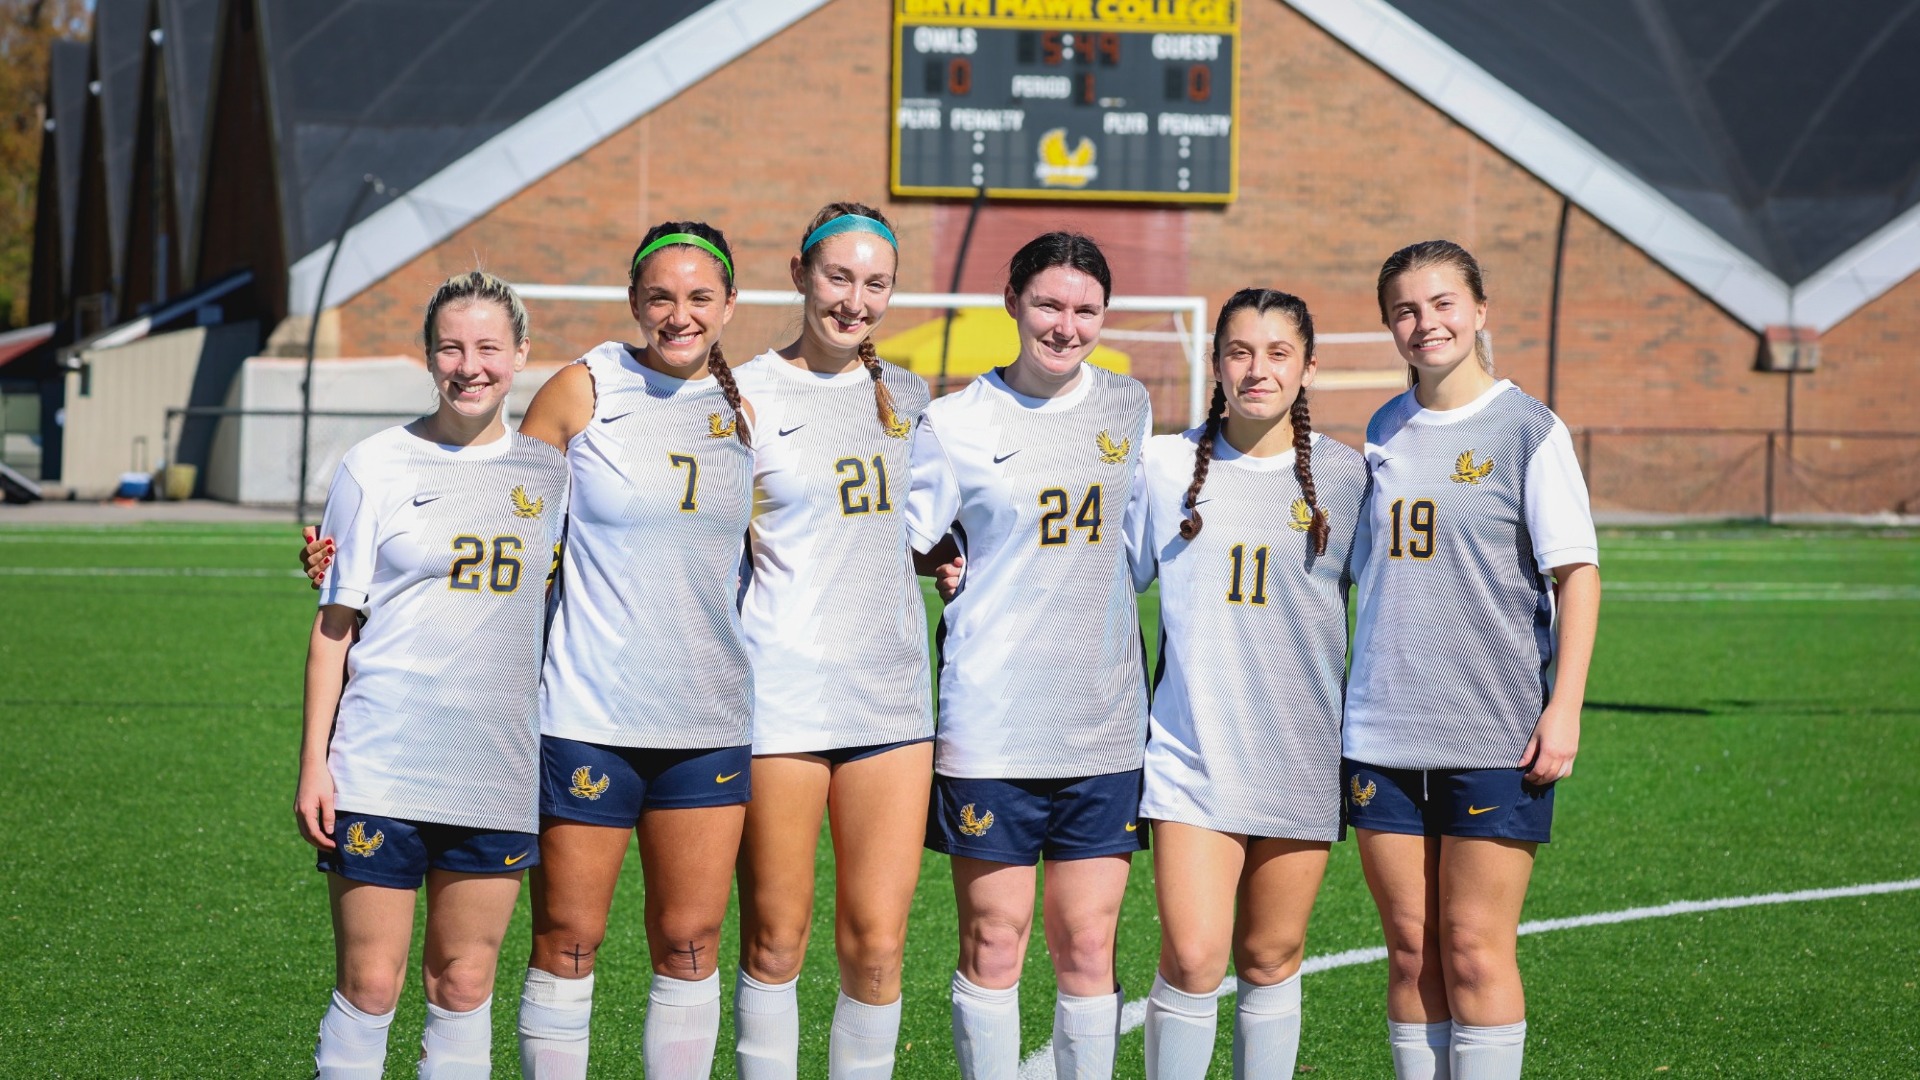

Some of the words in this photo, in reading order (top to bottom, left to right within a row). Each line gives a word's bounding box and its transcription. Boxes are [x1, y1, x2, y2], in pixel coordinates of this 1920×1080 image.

[914, 26, 978, 54] OWLS
[1152, 33, 1222, 60] GUEST
[949, 58, 972, 95] 0
[1012, 75, 1071, 98] PERIOD
[1188, 64, 1211, 102] 0
[951, 108, 1024, 131] PENALTY
[1158, 112, 1231, 136] PENALTY
[669, 453, 699, 513] 7
[835, 453, 894, 516] 21
[1039, 483, 1103, 548] 24
[1389, 497, 1437, 561] 19
[449, 534, 524, 594] 26
[1227, 543, 1270, 607] 11
